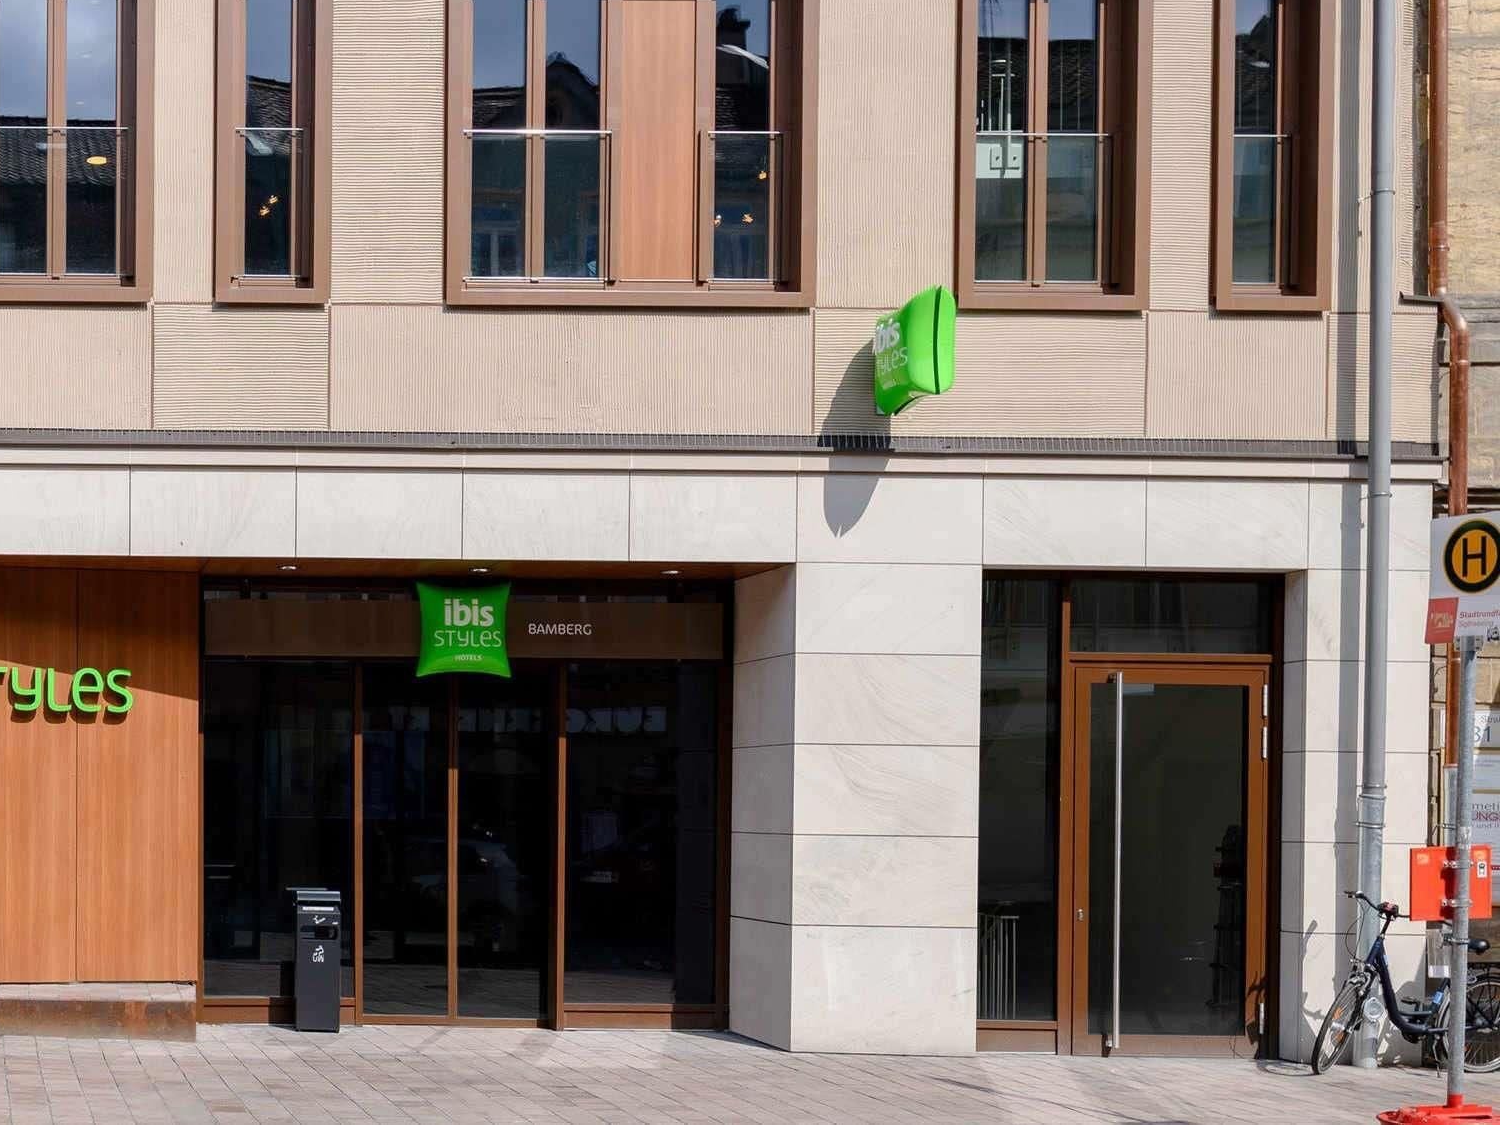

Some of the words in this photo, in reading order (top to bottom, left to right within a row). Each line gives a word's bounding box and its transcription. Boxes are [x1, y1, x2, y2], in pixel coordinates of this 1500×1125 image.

[1462, 535, 1487, 577] H
[444, 598, 494, 627] ibis
[528, 623, 592, 636] BAMBERG
